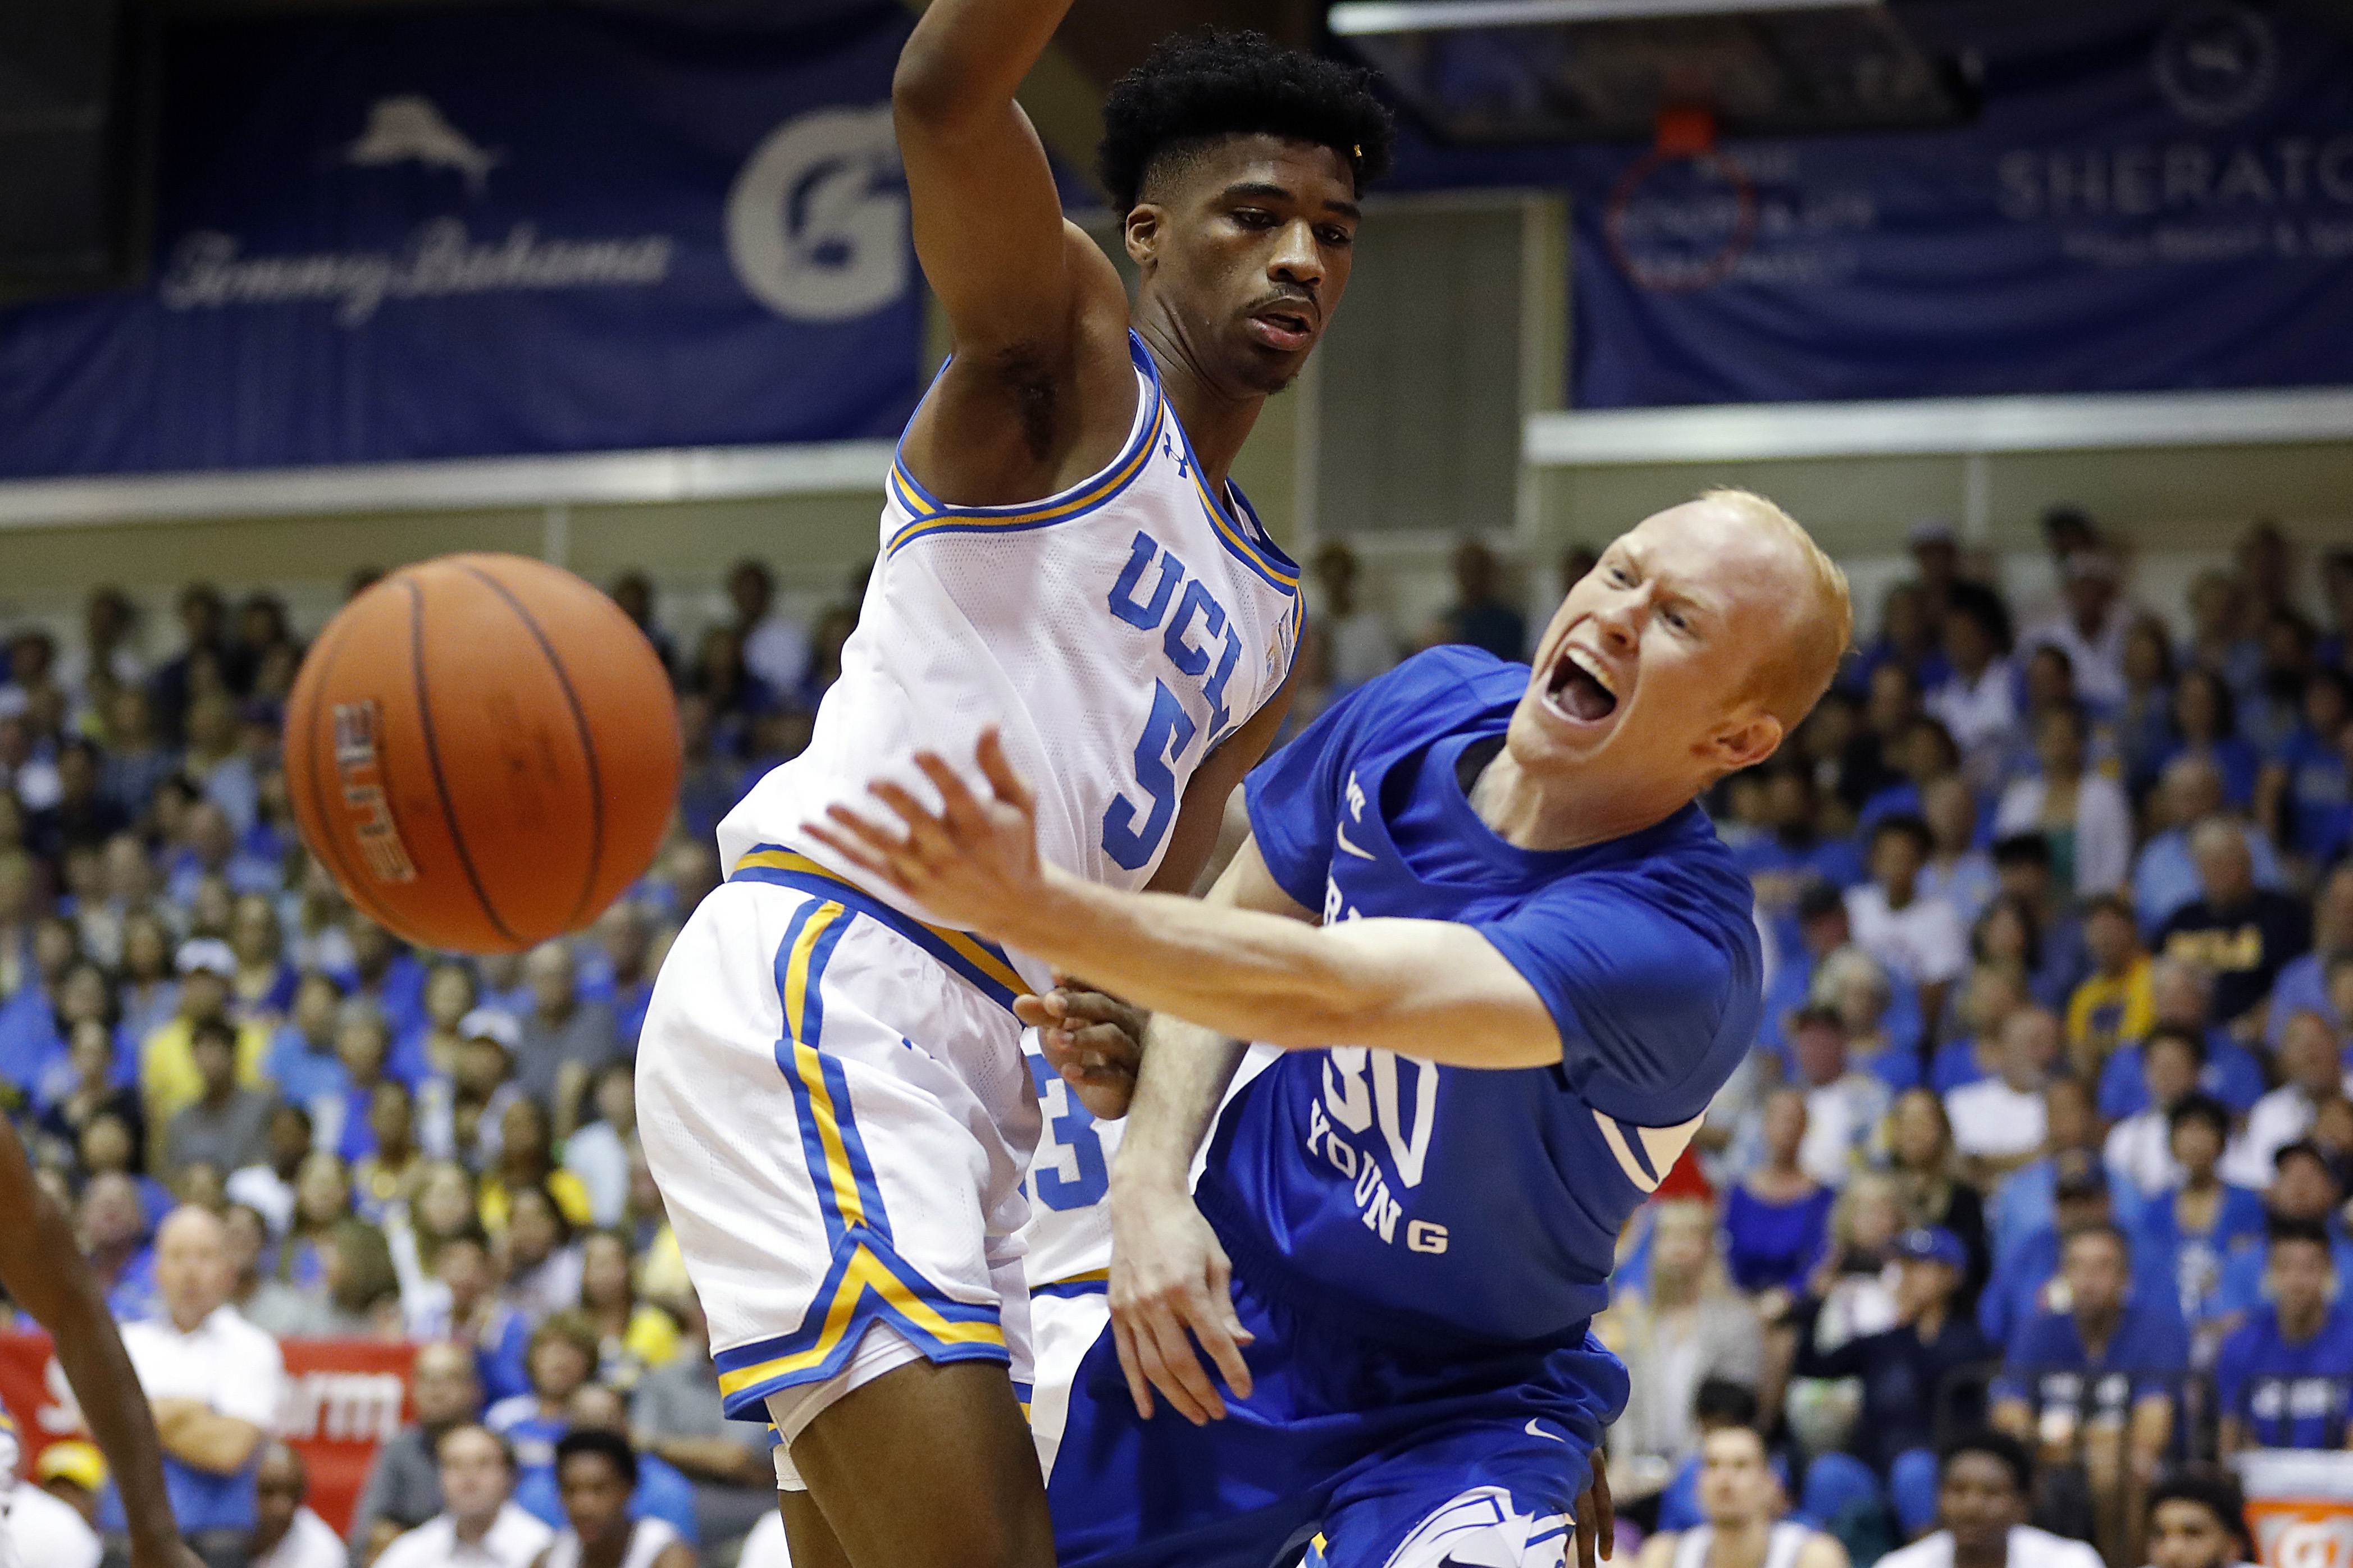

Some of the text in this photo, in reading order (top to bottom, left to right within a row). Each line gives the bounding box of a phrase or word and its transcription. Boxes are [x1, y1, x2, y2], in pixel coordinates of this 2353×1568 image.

[1108, 530, 1242, 742] UCL
[1101, 676, 1197, 871] 5
[1018, 1053, 1109, 1212] 3
[1307, 1098, 1449, 1254] YOUNG
[1322, 1046, 1439, 1188] 30
